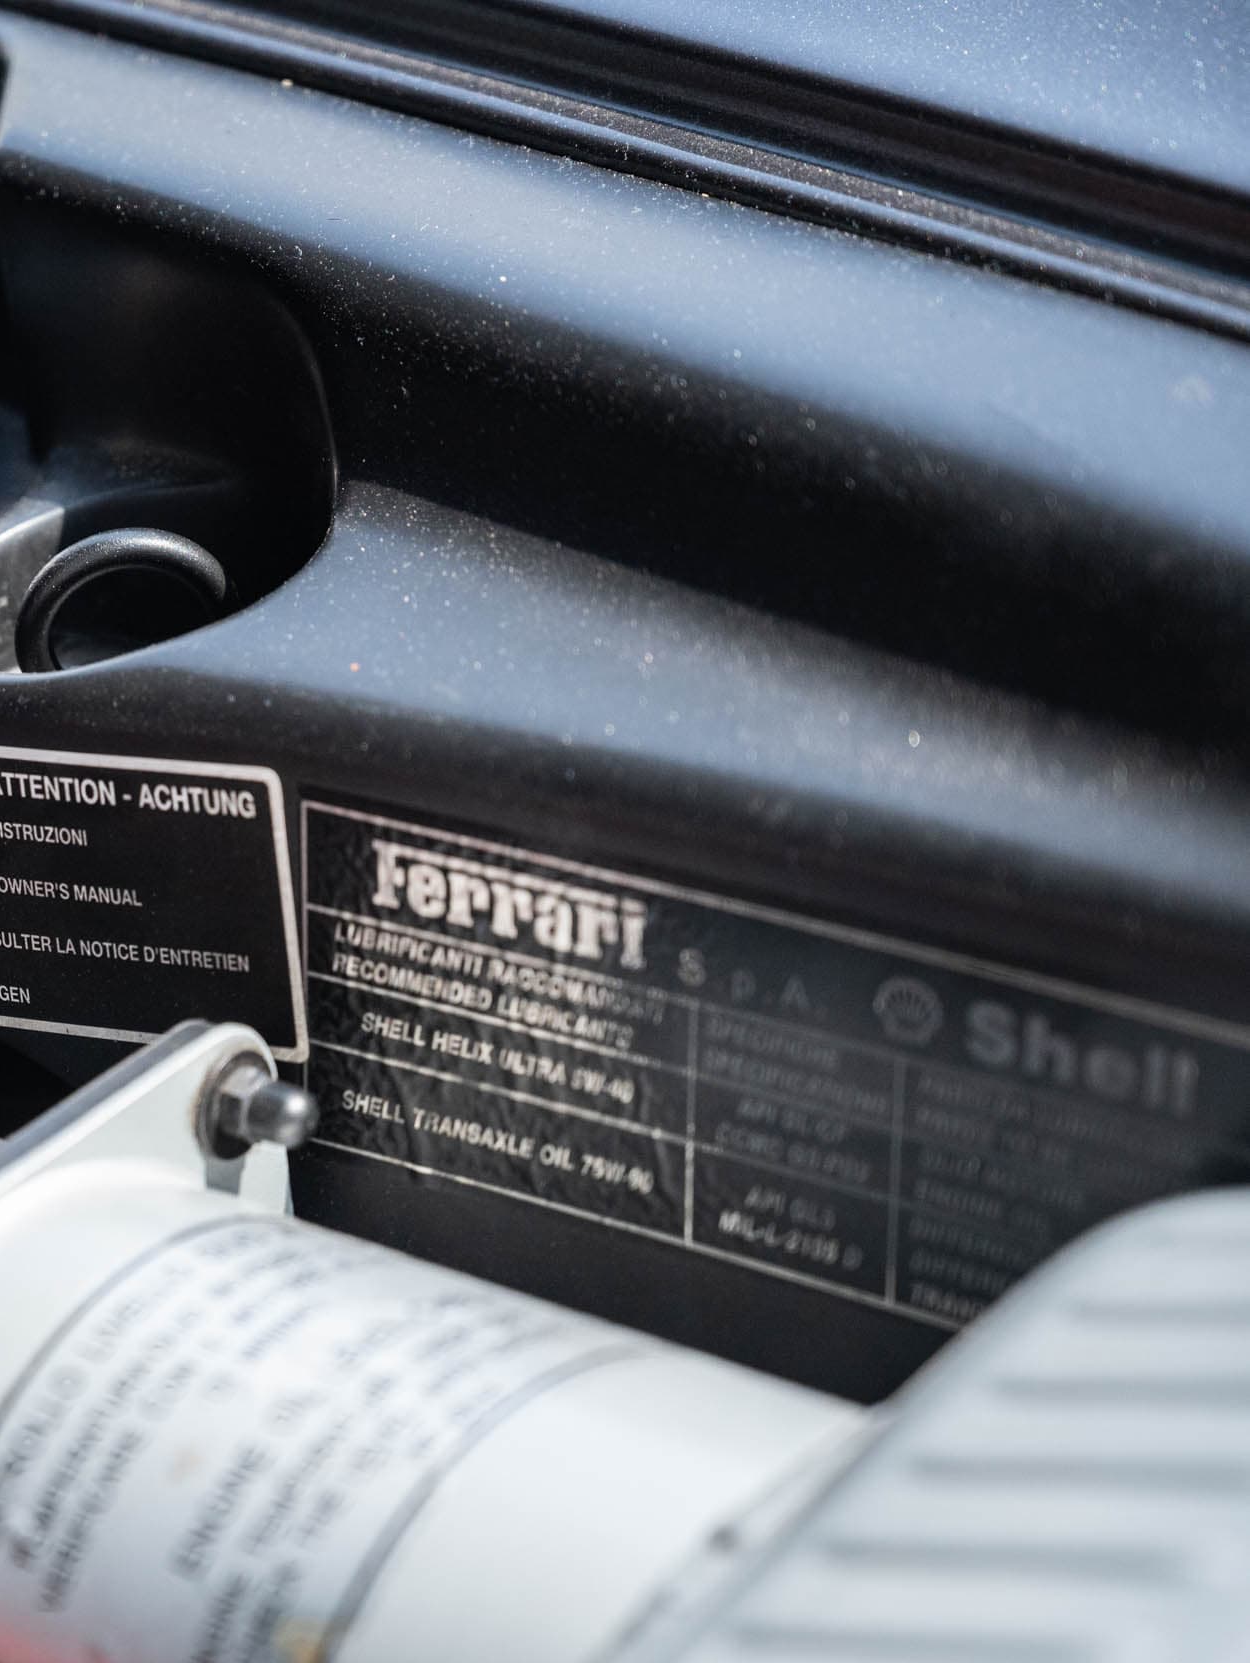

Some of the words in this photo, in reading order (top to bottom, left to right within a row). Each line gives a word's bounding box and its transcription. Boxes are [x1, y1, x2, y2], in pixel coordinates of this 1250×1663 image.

[139, 783, 257, 819] ACHTUNG
[74, 884, 143, 907] MANUAL
[371, 838, 648, 970] Ferrari
[55, 937, 76, 955] LA
[79, 939, 139, 962] NOTICE
[143, 946, 250, 973] D'ENTRETIEN
[334, 922, 484, 978] LUBRIFICANTI
[332, 953, 493, 1011] RECOMMENDED
[497, 995, 635, 1050] LUBRICANTS
[361, 1012, 426, 1047] SHELL
[431, 1030, 493, 1065] HELIX
[500, 1048, 566, 1086] ULTRA
[964, 999, 1200, 1119] Shell
[342, 1089, 405, 1124] SHELL
[412, 1107, 535, 1160] TRANSAXLE
[539, 1145, 575, 1172] OIL
